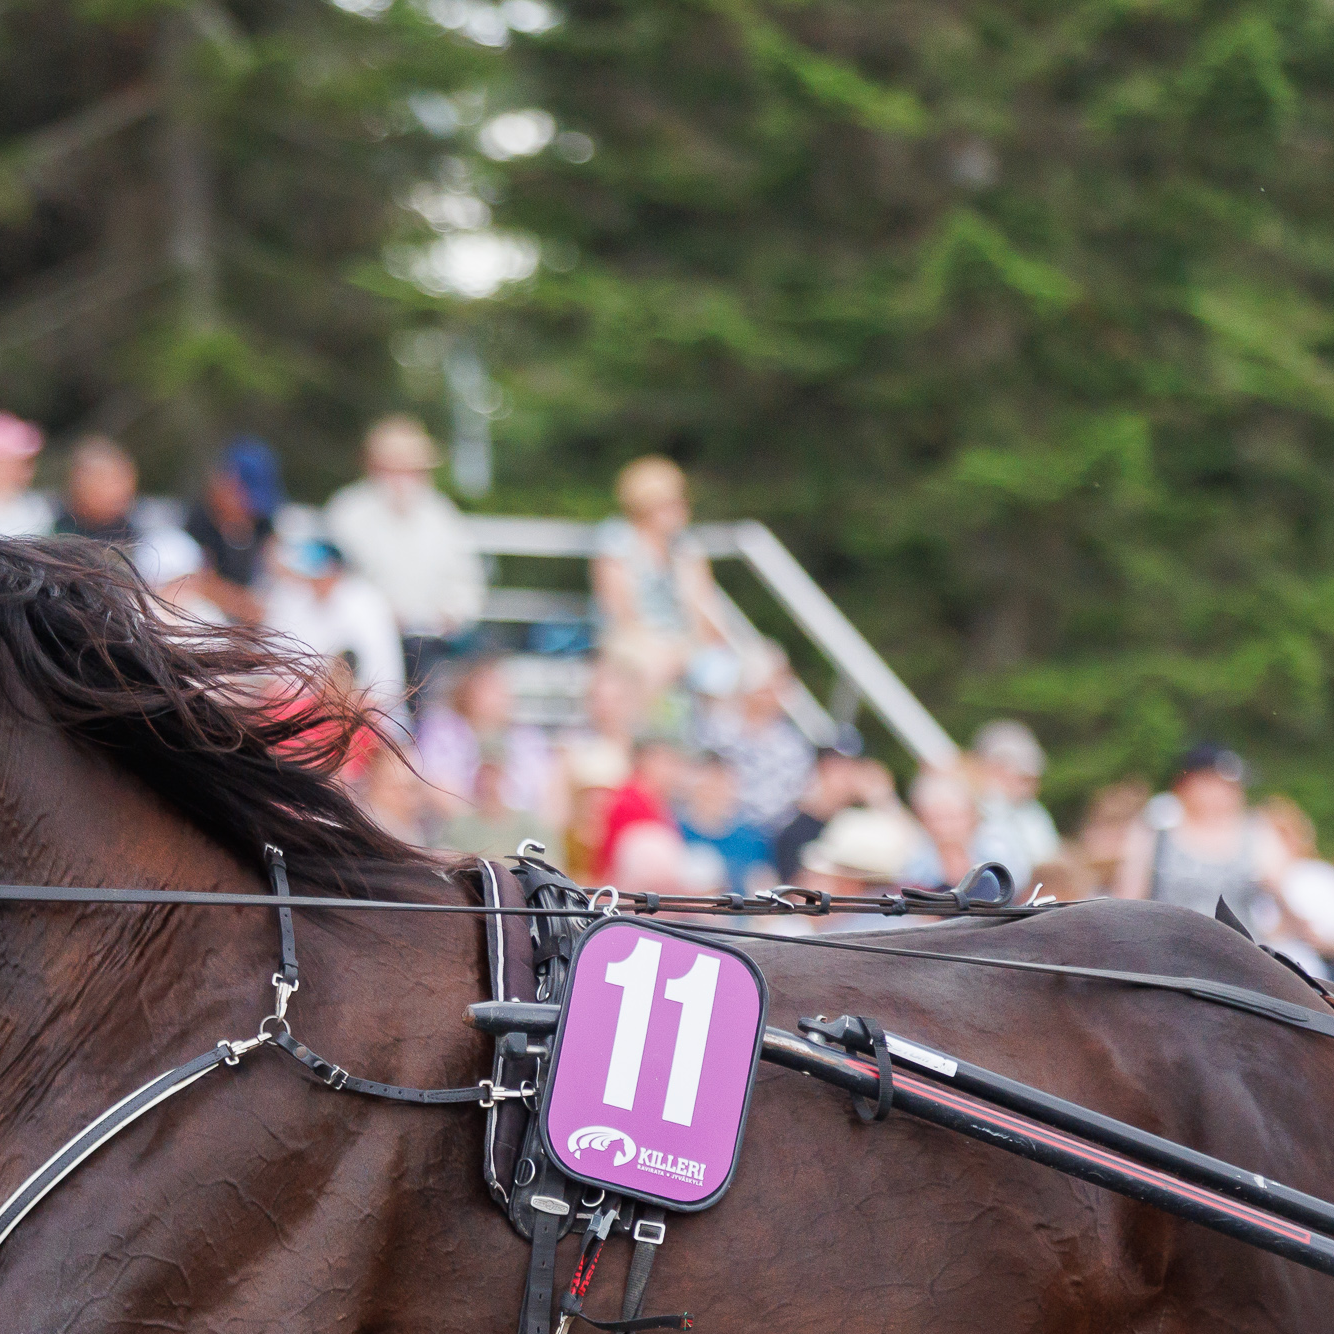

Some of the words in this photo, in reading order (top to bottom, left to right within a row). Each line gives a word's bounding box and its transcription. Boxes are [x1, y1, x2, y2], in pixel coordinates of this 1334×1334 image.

[602, 936, 721, 1127] 11
[637, 1164, 664, 1176] RAVIRATA
[671, 1173, 704, 1187] JYVÄSKYLÄ
[638, 1147, 706, 1181] KILLERI
